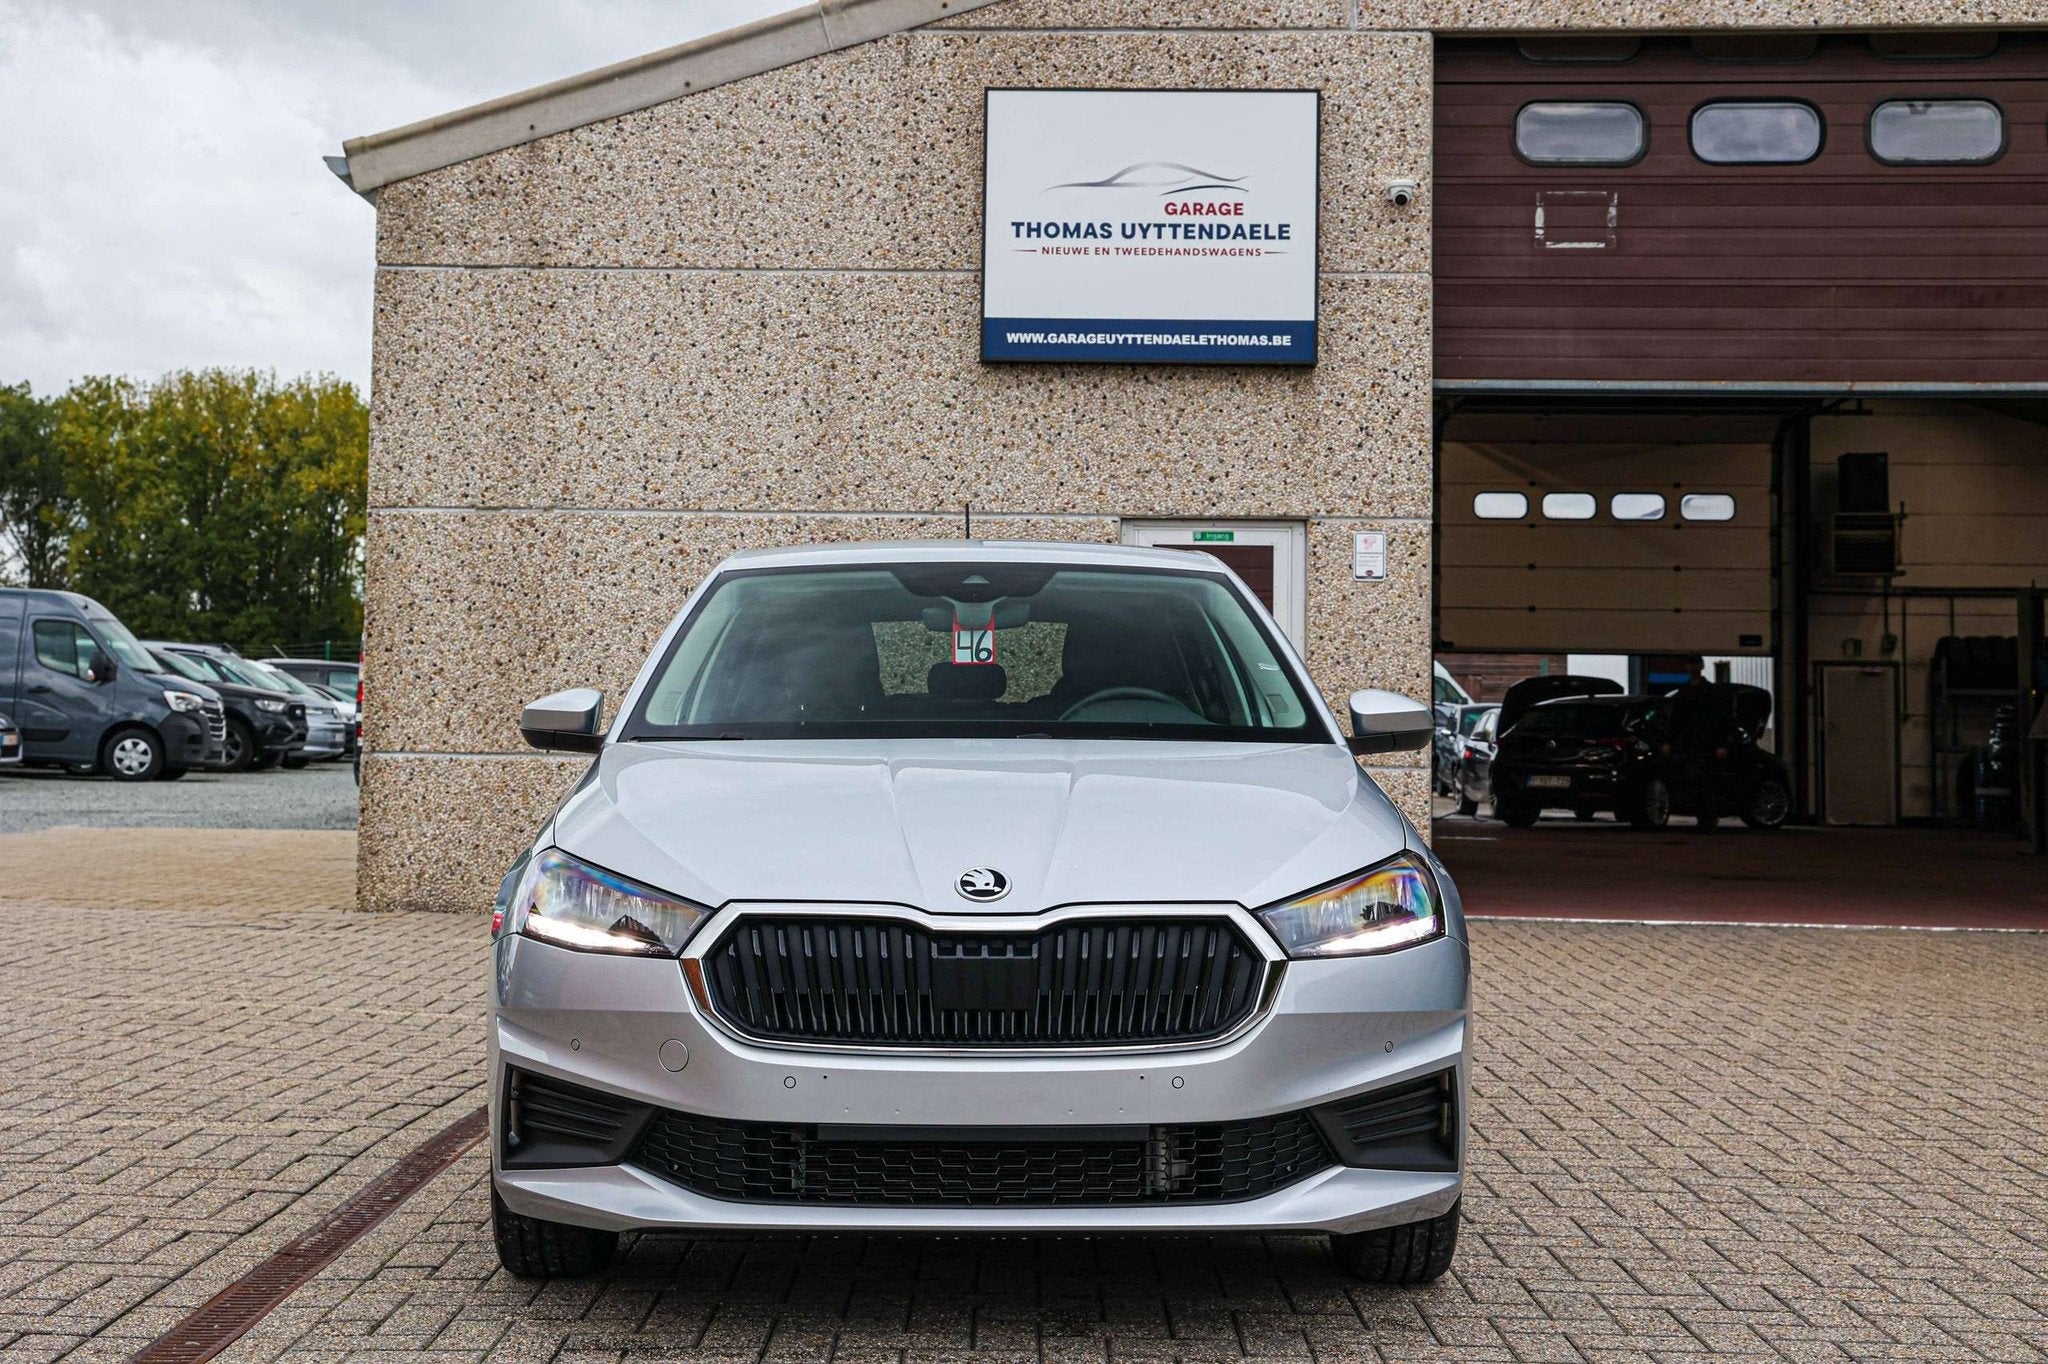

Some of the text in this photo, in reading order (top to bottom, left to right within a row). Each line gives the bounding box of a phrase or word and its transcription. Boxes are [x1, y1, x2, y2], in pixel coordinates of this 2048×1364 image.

[1164, 202, 1244, 216] GARAGE
[1011, 221, 1291, 241] THOMAS UYTTENDAELE
[1041, 246, 1262, 257] NIEUWE EN TWEEDEHANDSWAGENS
[1006, 332, 1292, 347] WWW.GARAGEUYTTENDAELETHOMAS.BE
[957, 630, 993, 662] 46
